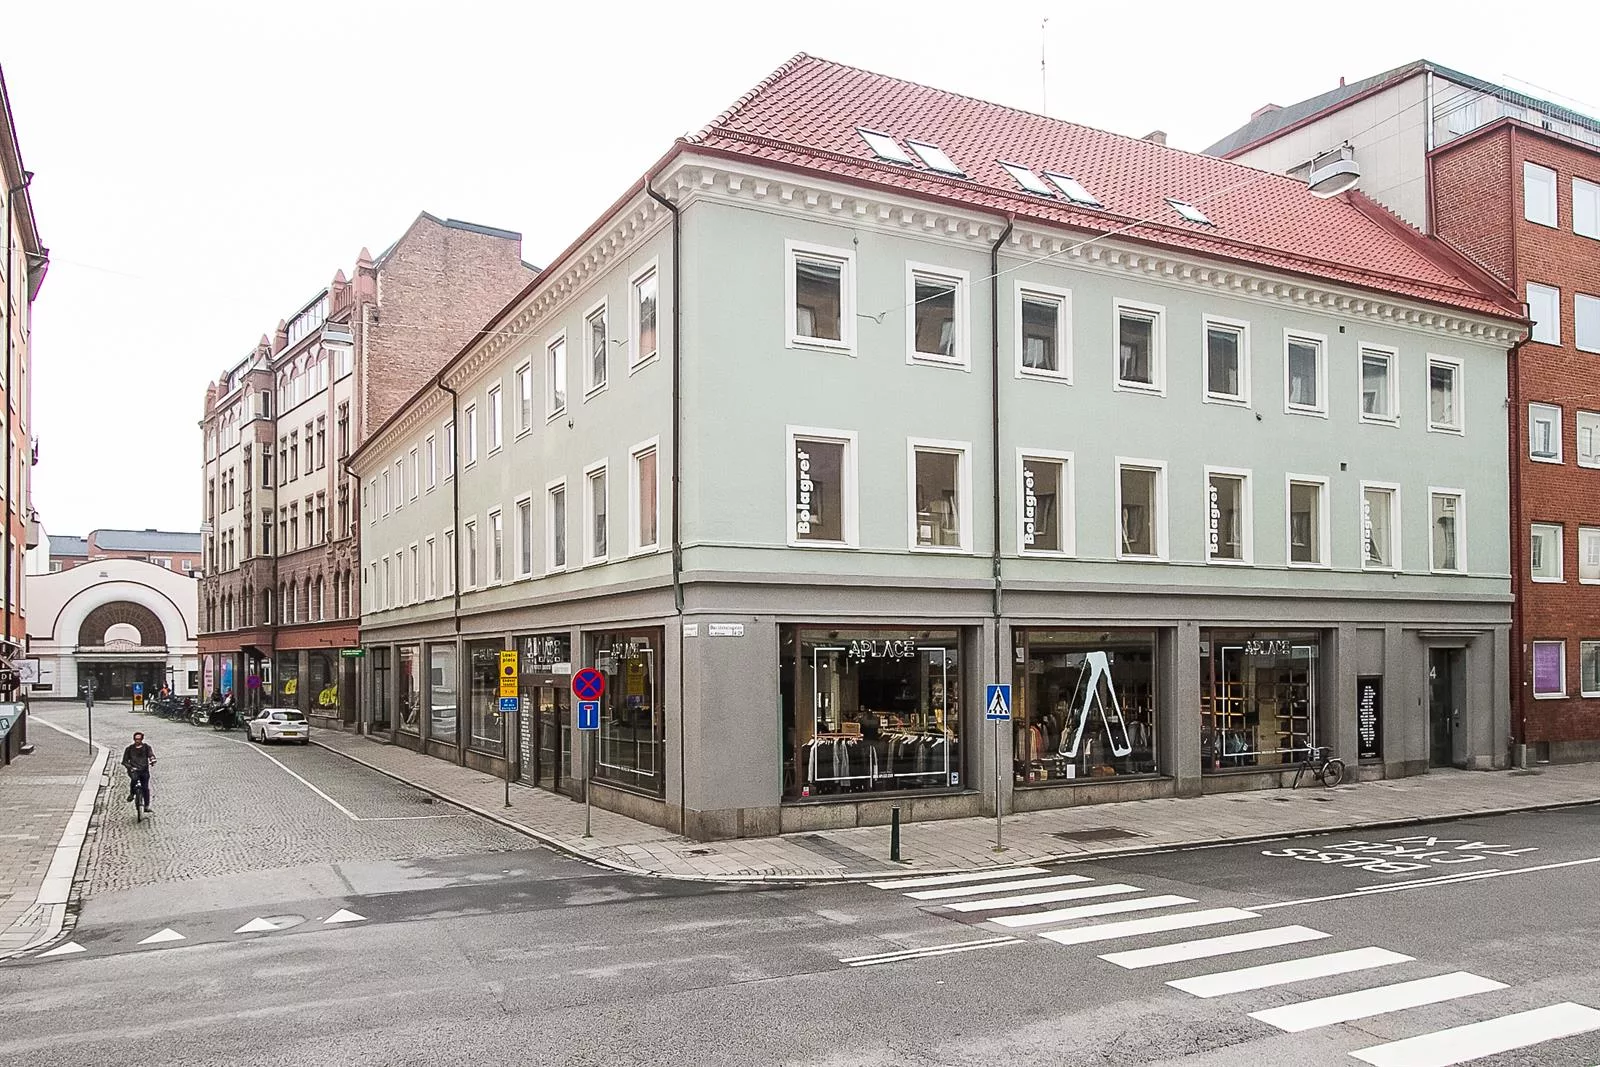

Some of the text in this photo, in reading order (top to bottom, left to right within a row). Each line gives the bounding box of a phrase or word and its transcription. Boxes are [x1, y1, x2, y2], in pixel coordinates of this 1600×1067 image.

[848, 640, 915, 658] APLACE
[1244, 640, 1290, 655] APLACE
[1430, 665, 1437, 679] 4
